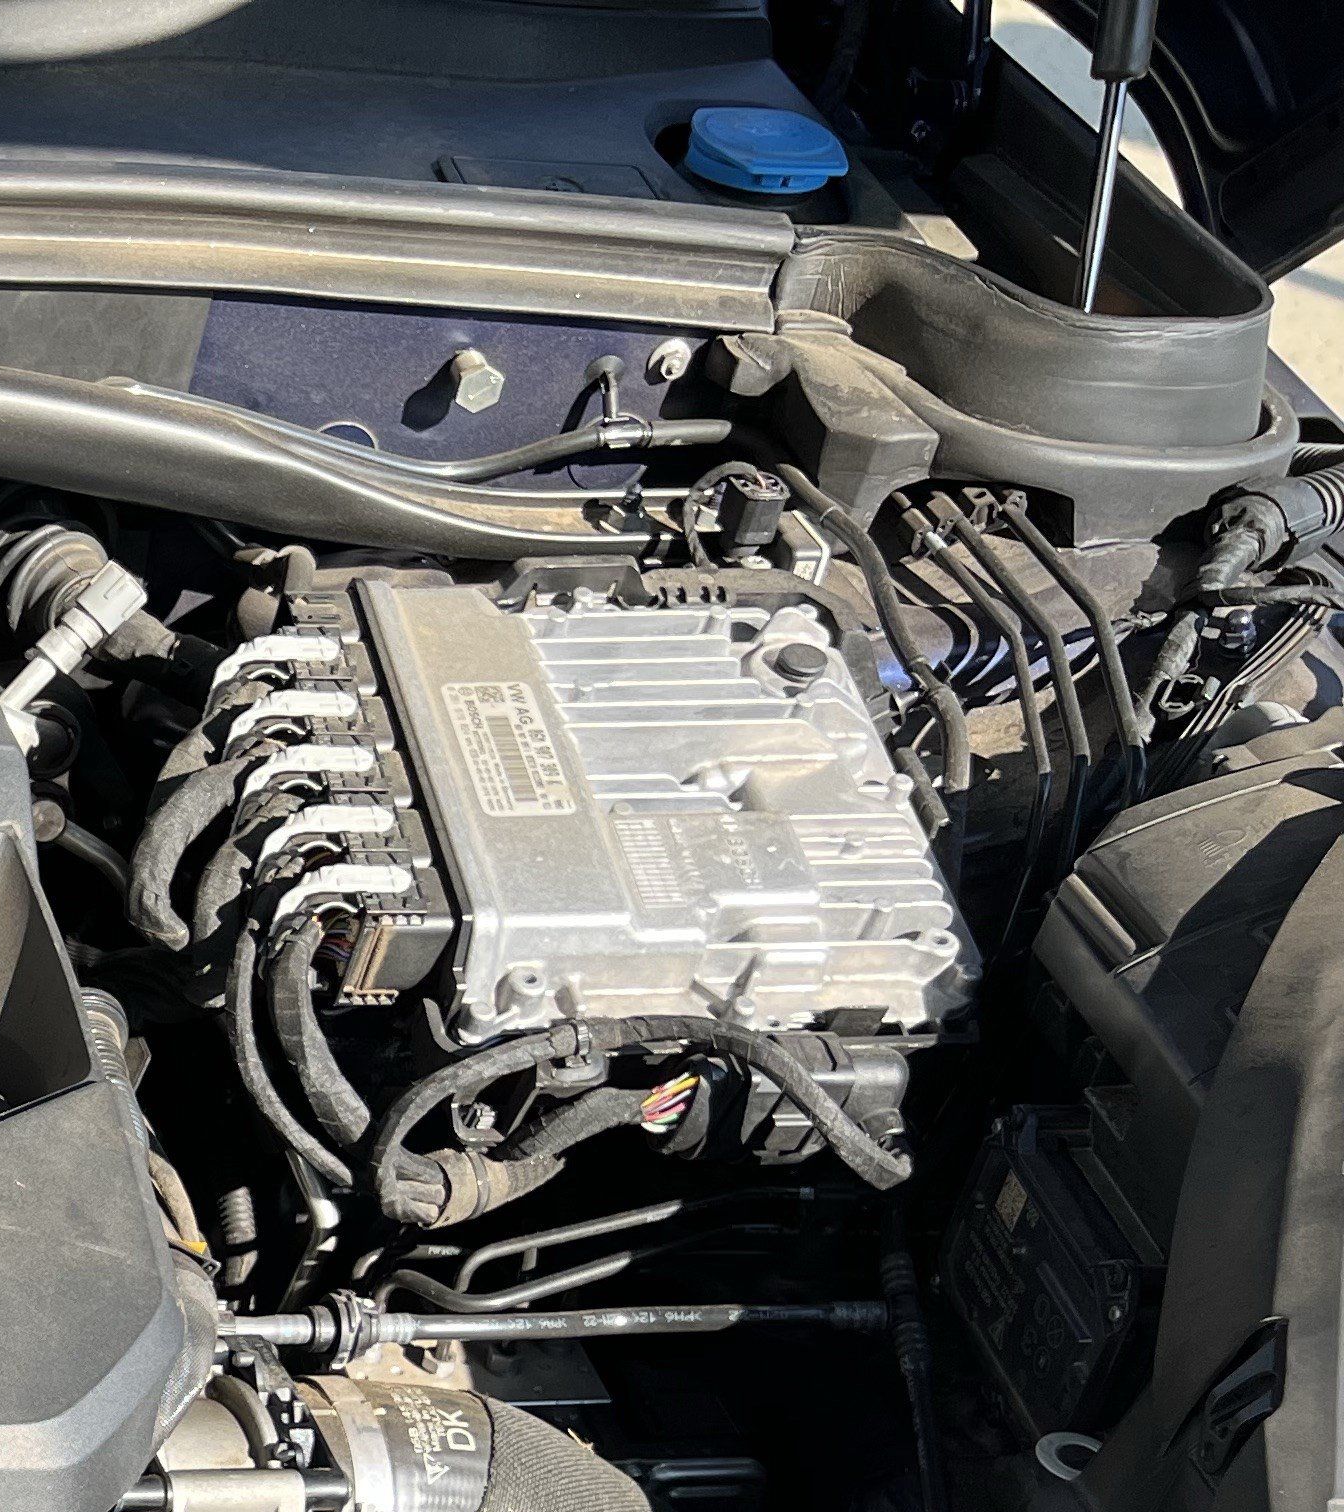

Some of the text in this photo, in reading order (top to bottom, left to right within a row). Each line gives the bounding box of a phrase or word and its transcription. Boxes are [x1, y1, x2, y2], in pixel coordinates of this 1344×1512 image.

[464, 700, 483, 729] BOSCH
[515, 706, 534, 725] AG
[436, 1408, 476, 1452] DK
